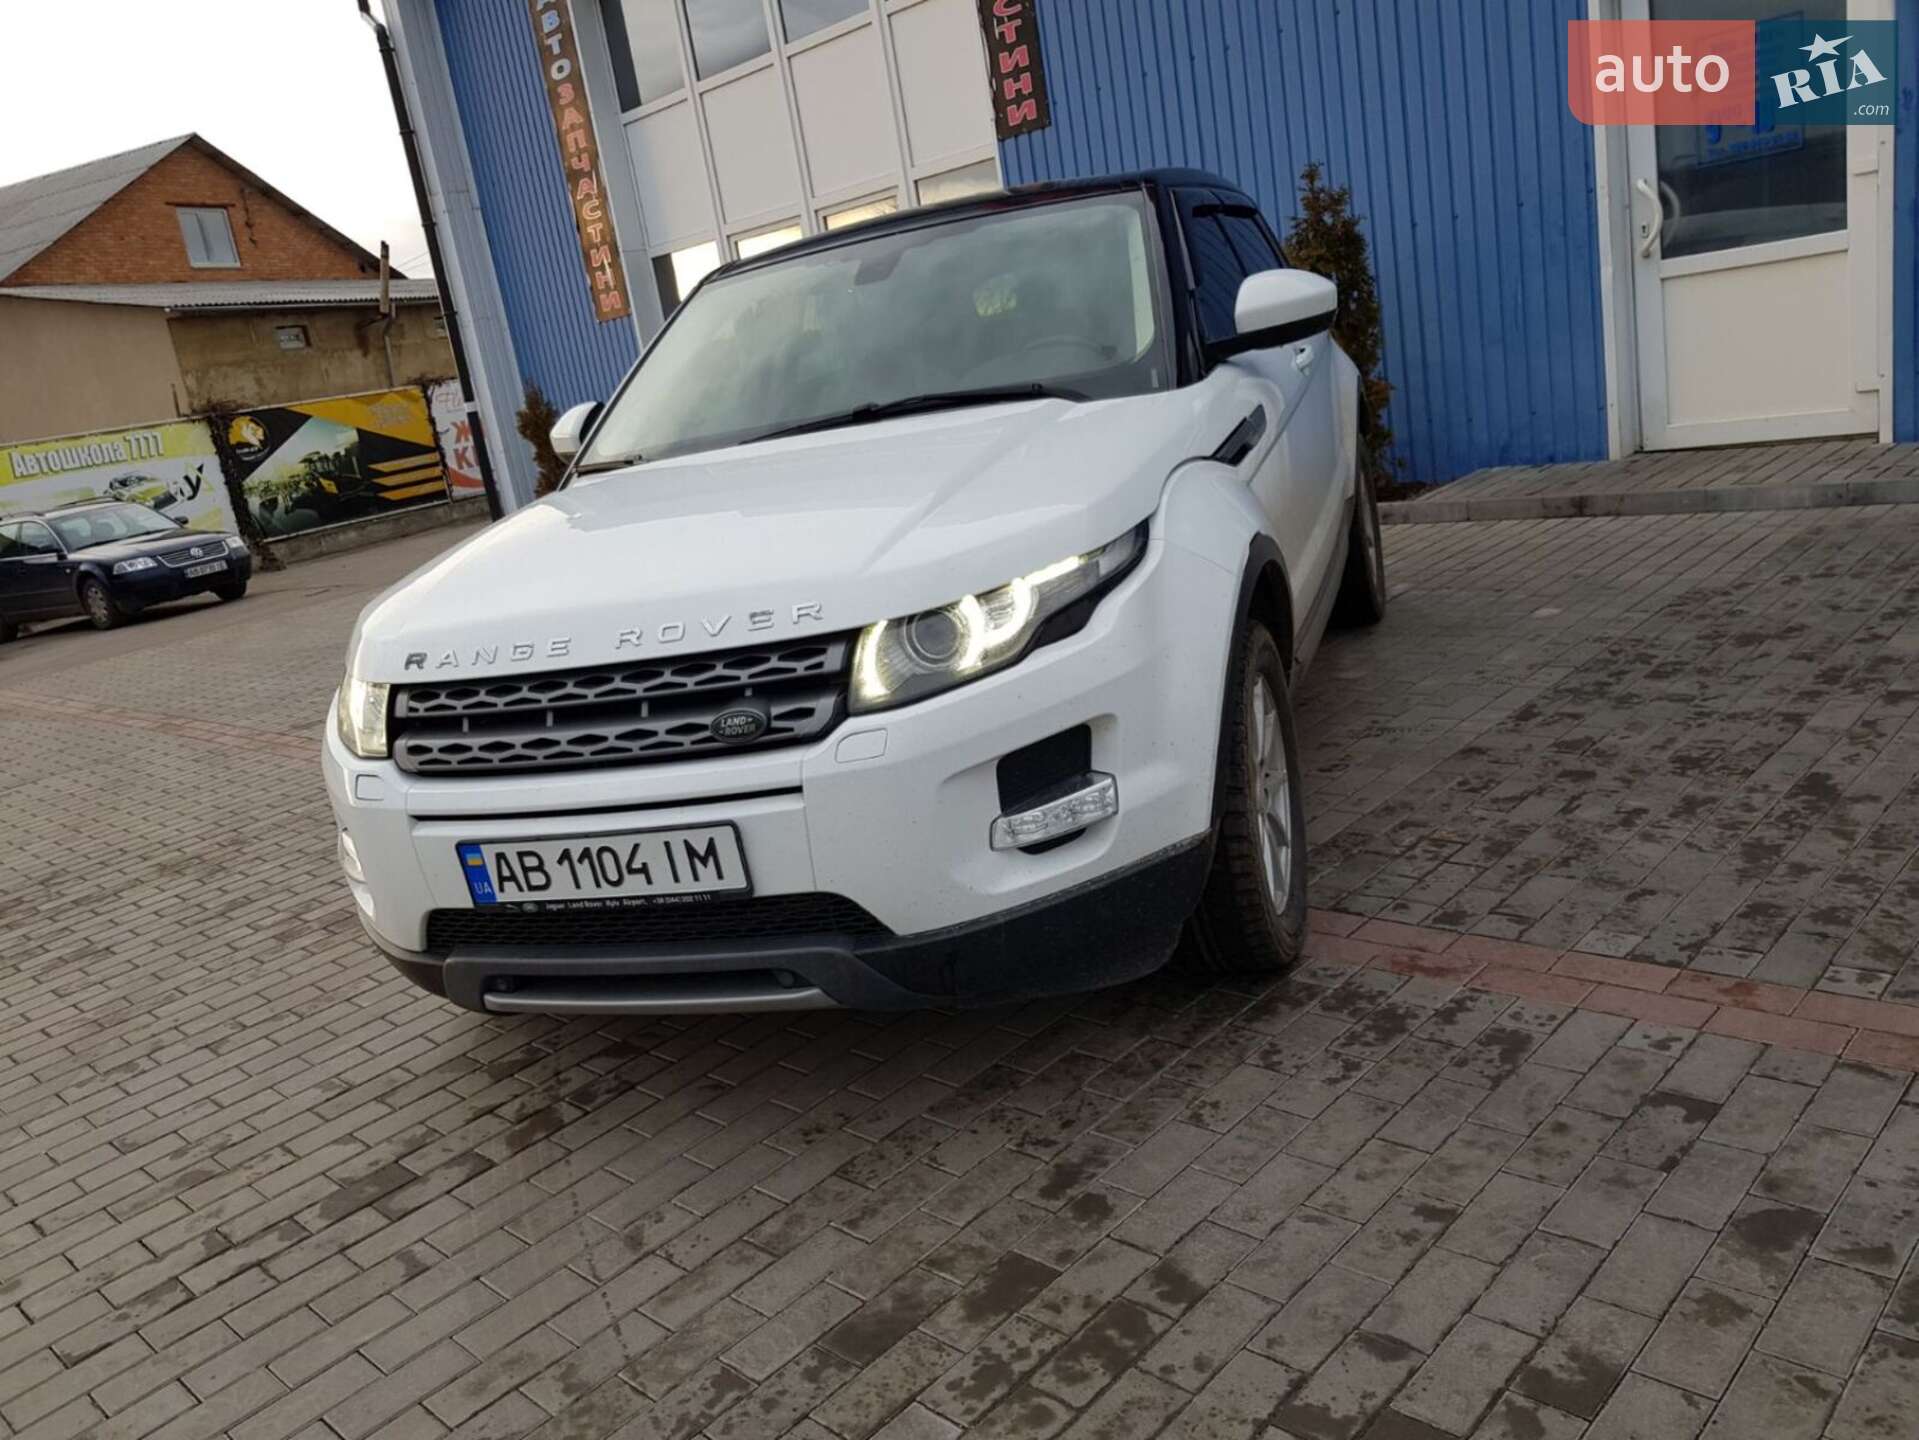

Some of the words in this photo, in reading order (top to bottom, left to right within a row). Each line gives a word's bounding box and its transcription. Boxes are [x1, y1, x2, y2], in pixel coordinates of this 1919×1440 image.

[403, 637, 572, 672] RANGE
[613, 600, 825, 650] ROVER
[474, 880, 493, 894] UA
[495, 850, 552, 893] AB
[557, 843, 653, 890] 1104
[663, 837, 725, 884] IM
